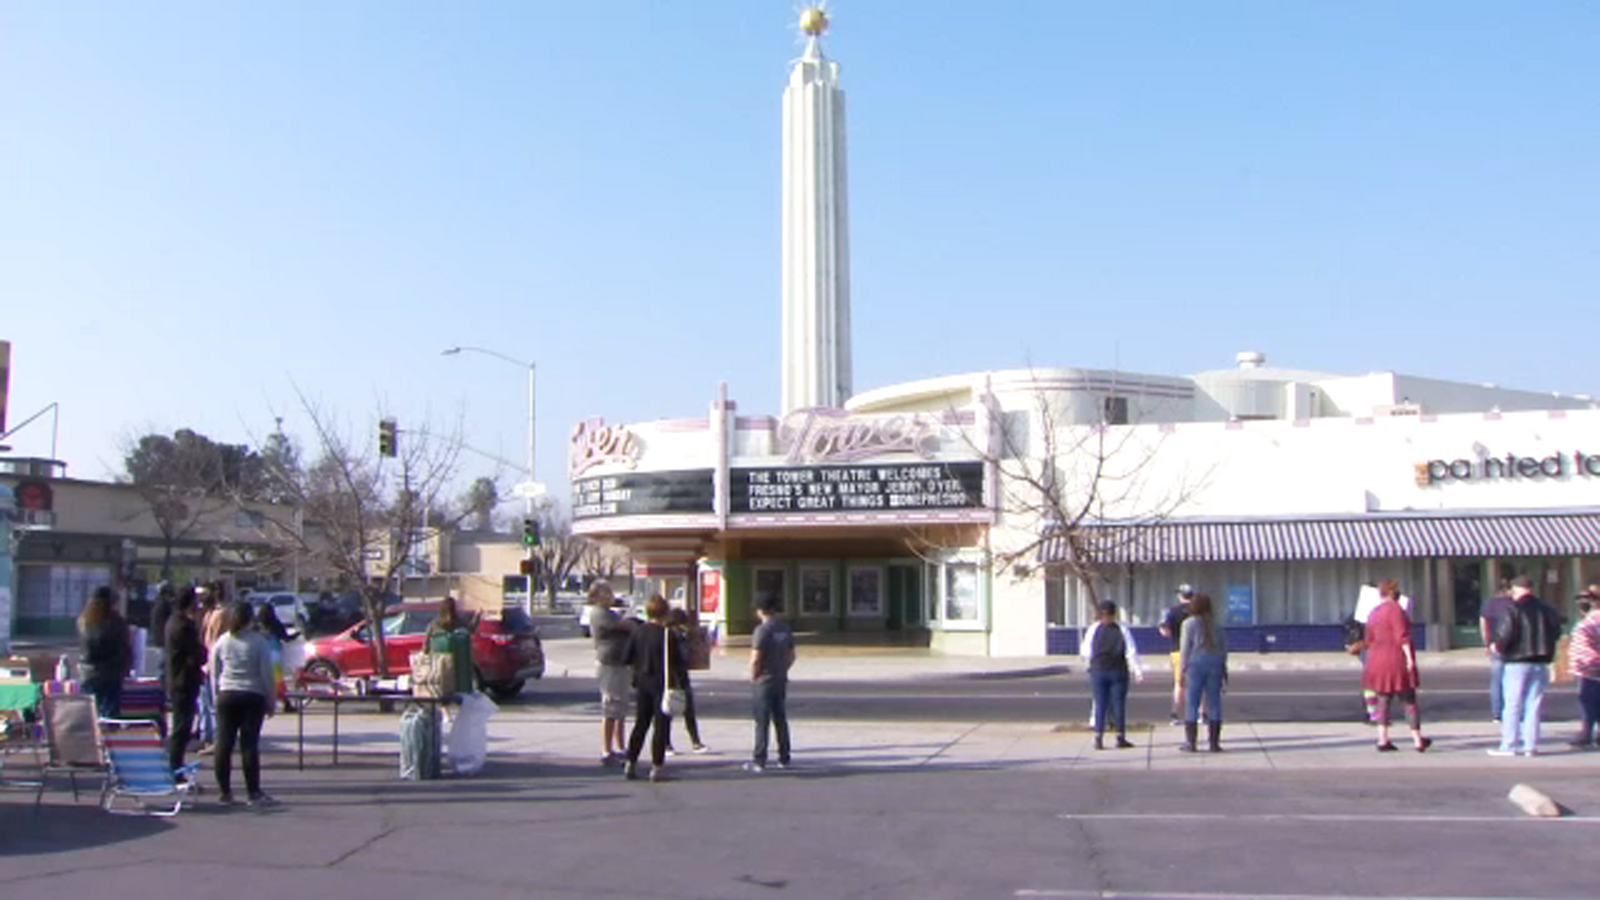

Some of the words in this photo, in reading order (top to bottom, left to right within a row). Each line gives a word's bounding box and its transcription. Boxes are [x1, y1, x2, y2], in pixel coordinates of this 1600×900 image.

[777, 407, 936, 464] Tower
[1429, 444, 1562, 485] painted
[749, 472, 770, 483] THE
[775, 470, 813, 483] TOWER
[821, 468, 872, 482] THEATRE
[877, 466, 941, 481] WELCOMES
[749, 483, 803, 497] FRESNO'S
[808, 482, 832, 495] NEW
[839, 481, 880, 495] MAYOR
[885, 480, 922, 493] JERRY
[749, 496, 792, 510] EXPECT
[797, 495, 836, 509] GREAT
[842, 494, 884, 508] THINGS
